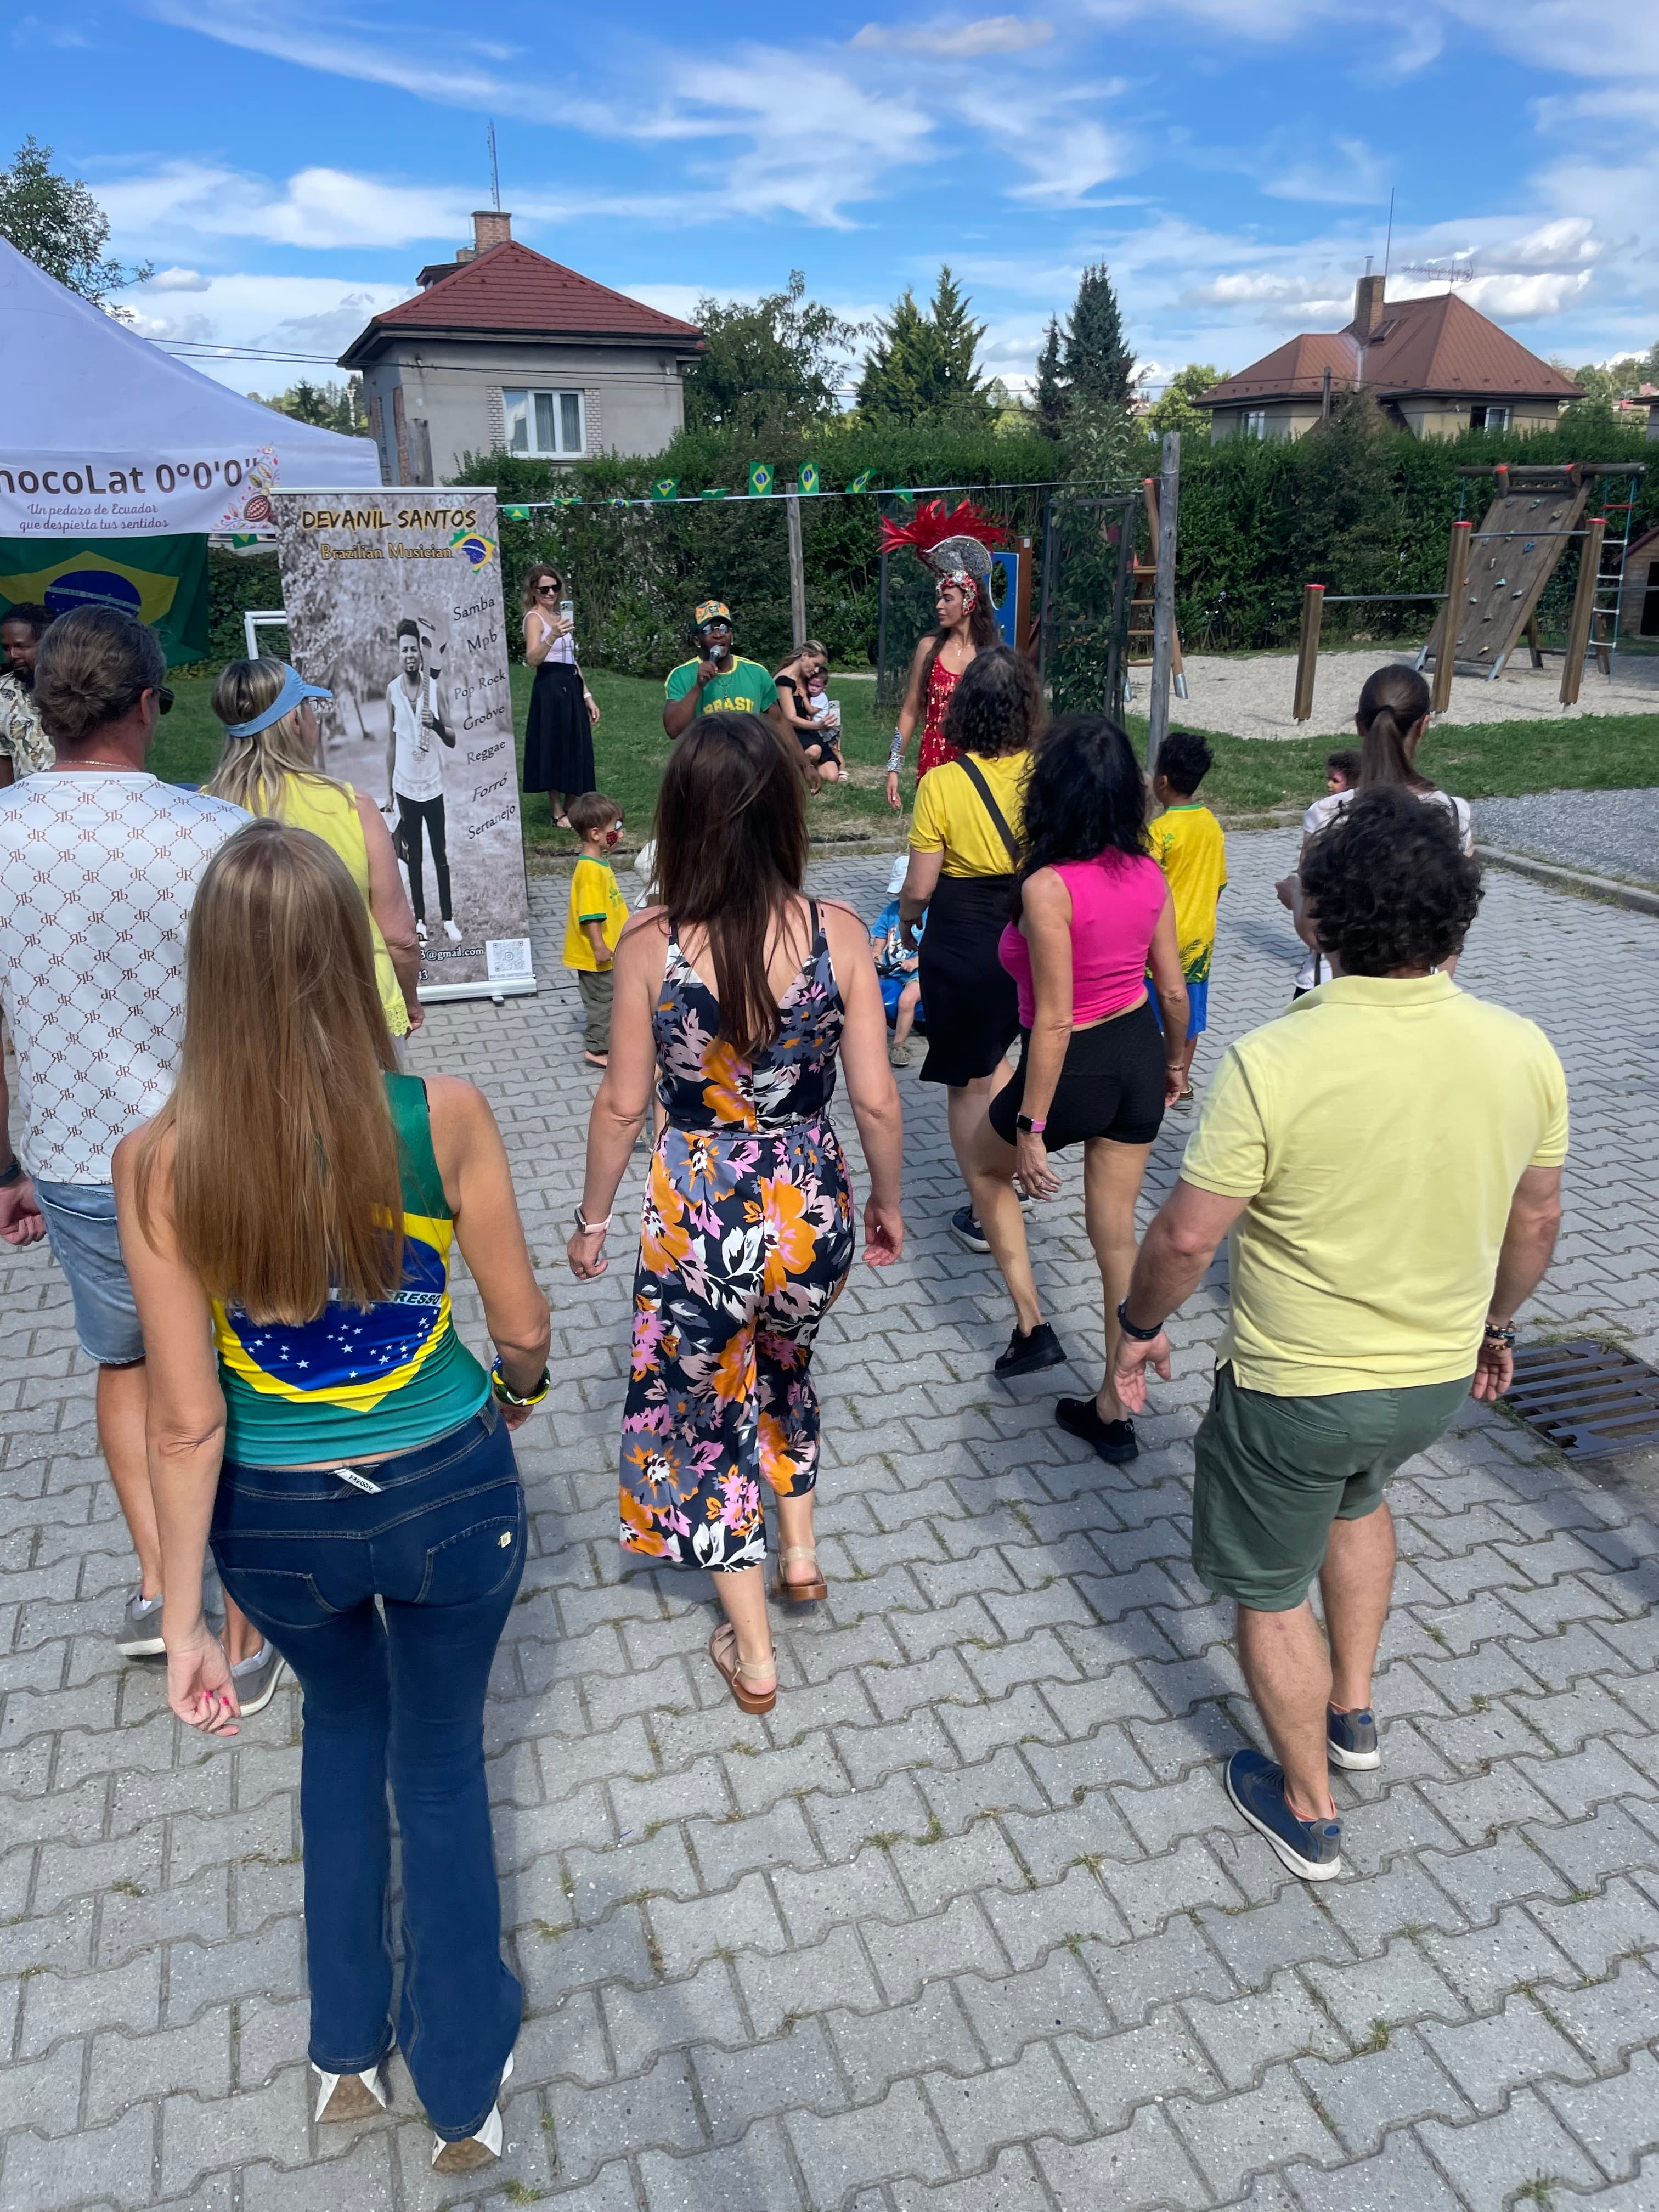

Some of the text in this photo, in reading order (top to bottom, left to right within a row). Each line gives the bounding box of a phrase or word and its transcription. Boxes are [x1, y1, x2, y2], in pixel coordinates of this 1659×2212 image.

[27, 503, 158, 520] Un pedazo de Ecuador
[302, 509, 477, 531] DEVANIL SANTOS
[20, 517, 168, 534] que despierta tus sentidos
[321, 542, 453, 560] Brazilian Musician
[453, 597, 495, 621] Samba
[467, 629, 498, 653] Mpb
[454, 669, 506, 700] Pop Rock
[462, 704, 505, 730] Groove
[466, 740, 506, 765] Reggae
[472, 772, 509, 802] Forró
[469, 805, 516, 839] Sertanejo
[348, 1474, 374, 1491] FREDDY
